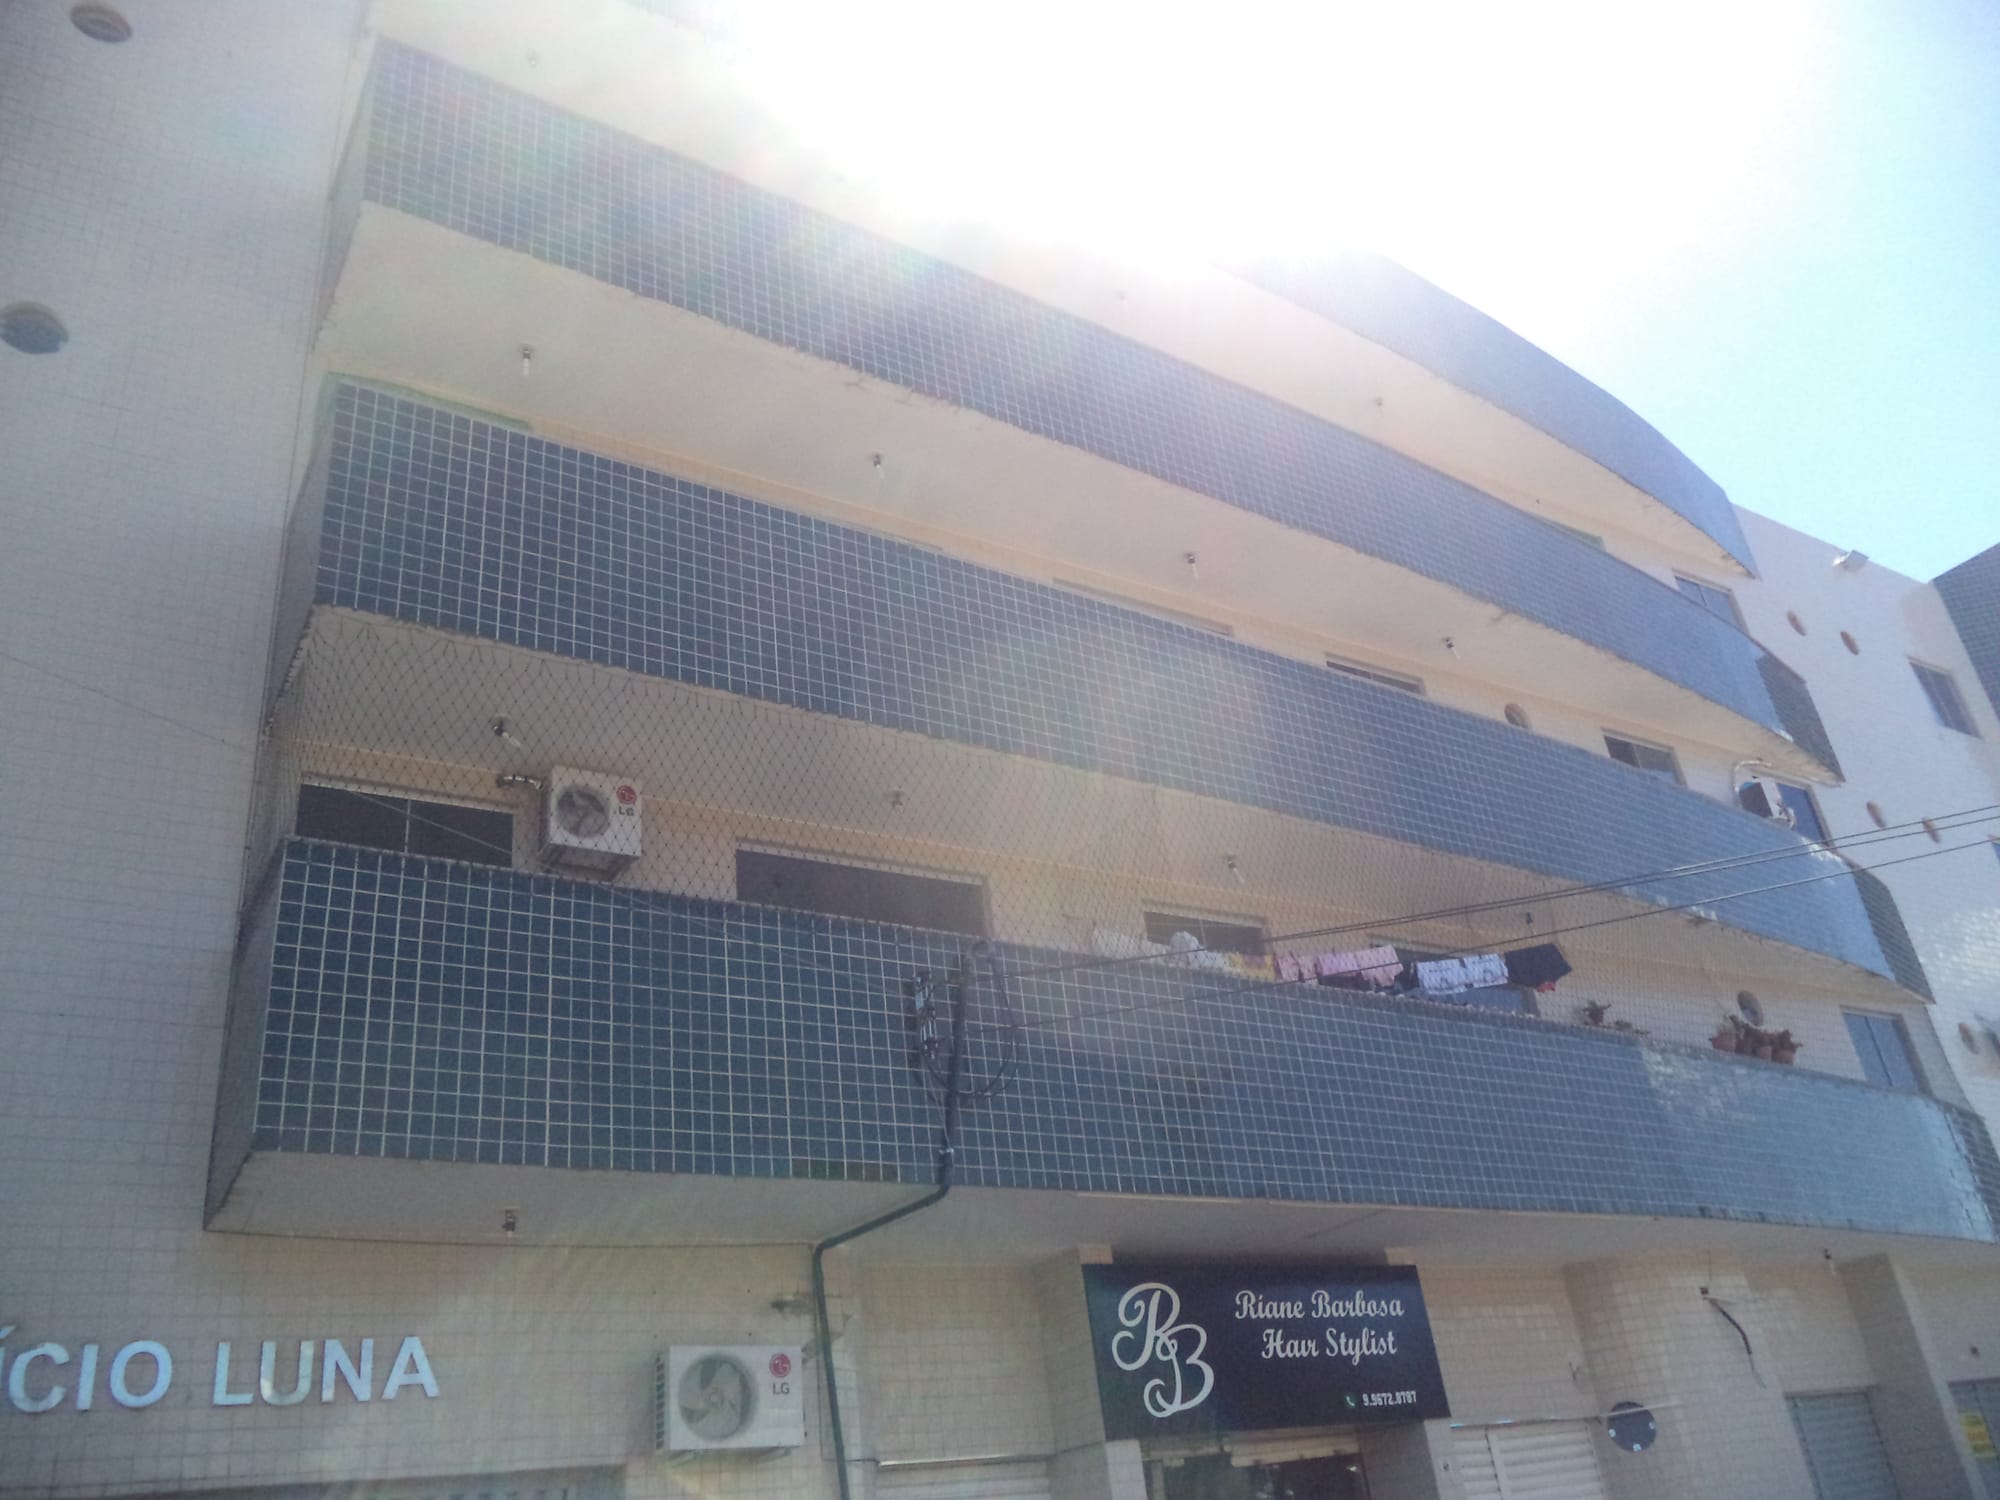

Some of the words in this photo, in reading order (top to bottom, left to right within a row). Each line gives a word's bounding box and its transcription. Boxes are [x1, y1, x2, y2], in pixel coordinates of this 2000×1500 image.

[1234, 1290, 1305, 1320] Riane
[1311, 1290, 1405, 1319] Barbosa
[1325, 1327, 1398, 1366] Stylist
[212, 1335, 441, 1407] LUNA
[772, 1382, 791, 1396] LG
